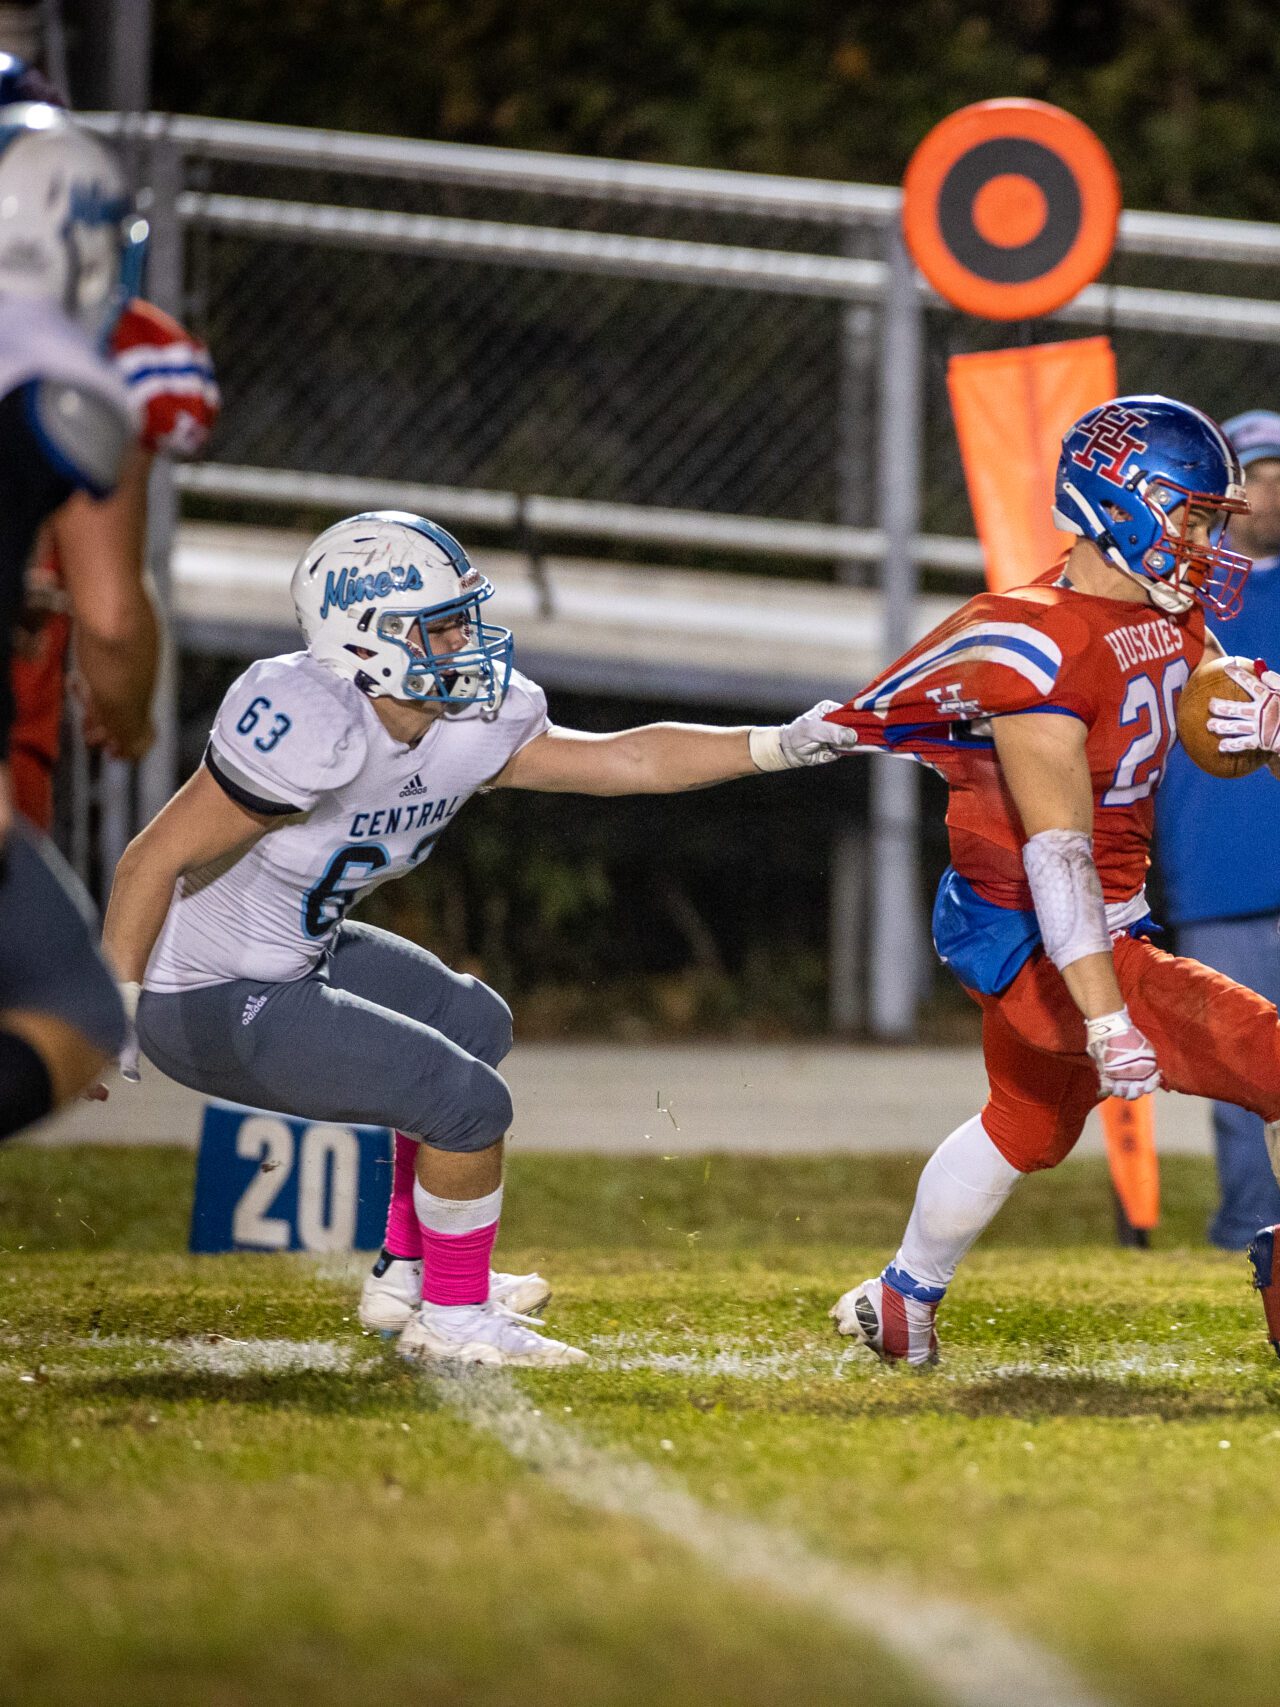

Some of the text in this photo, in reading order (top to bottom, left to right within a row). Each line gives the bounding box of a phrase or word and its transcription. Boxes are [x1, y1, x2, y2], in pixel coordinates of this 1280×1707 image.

[320, 564, 423, 619] Miners
[1104, 618, 1183, 672] HUSKIES
[236, 696, 291, 752] 63
[349, 796, 458, 837] CENTRAL
[399, 785, 428, 798] adidas
[232, 1115, 359, 1254] 20
